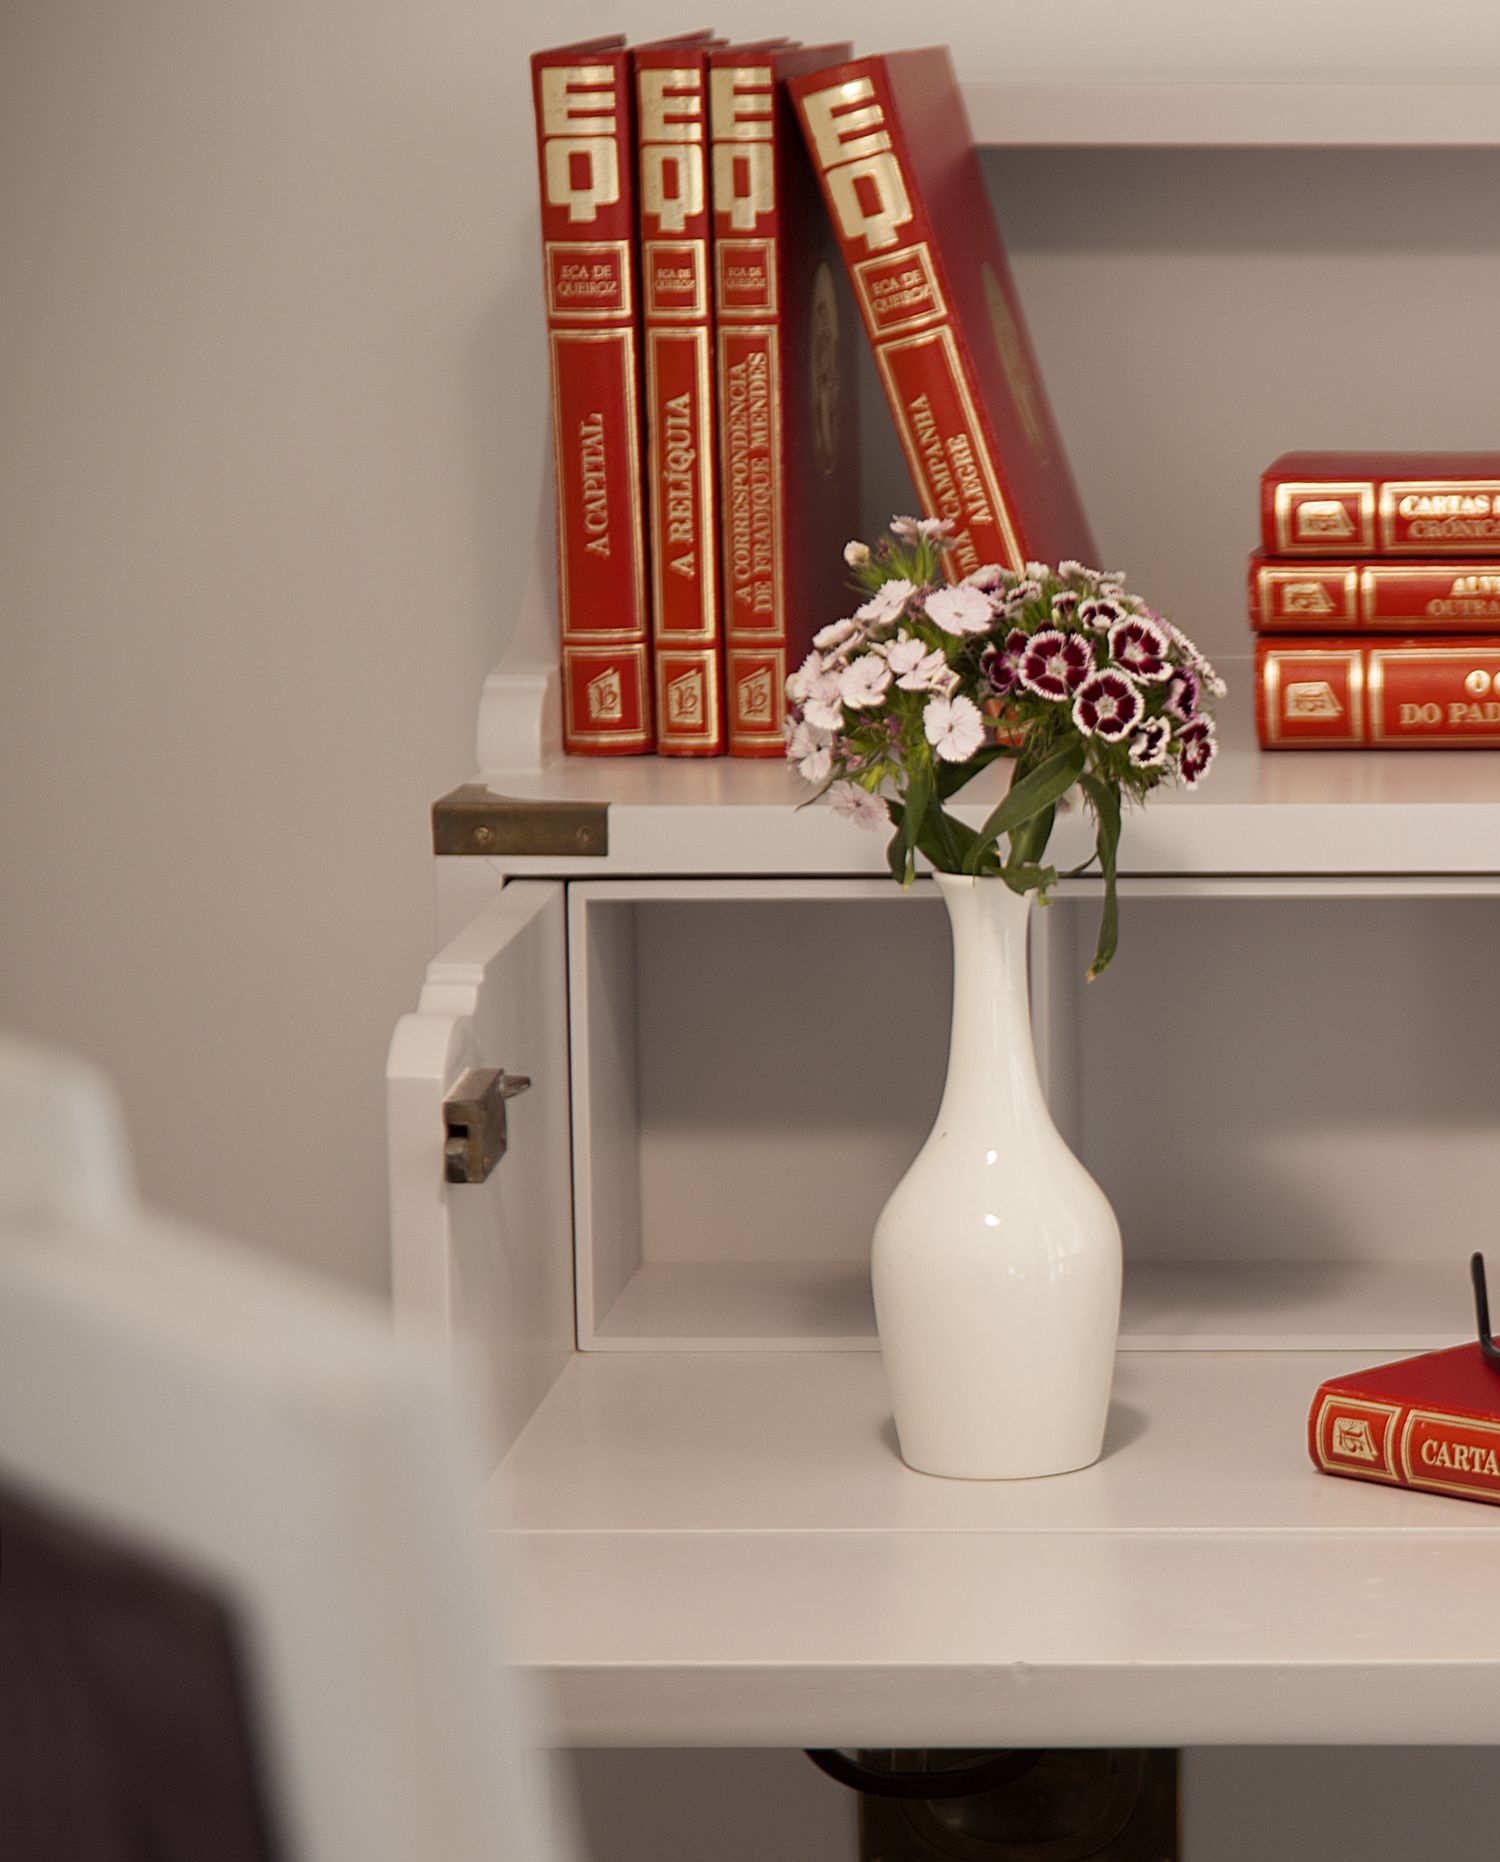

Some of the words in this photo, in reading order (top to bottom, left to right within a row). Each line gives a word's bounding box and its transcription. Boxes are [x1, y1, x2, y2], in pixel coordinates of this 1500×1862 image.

[592, 264, 612, 279] DE
[654, 279, 696, 292] QUEIROZ
[677, 267, 692, 279] DE
[557, 280, 618, 298] QUEIROZ
[748, 351, 769, 450] MENDES
[664, 392, 696, 546] RELÍQUIA
[910, 391, 962, 519] CAMPANHA
[579, 412, 609, 534] CAPITAL
[945, 433, 994, 526] ALEGRE
[750, 456, 774, 574] FRADIQUE
[1399, 493, 1490, 519] CARTAS
[584, 532, 611, 557] A
[669, 551, 696, 581] A
[735, 584, 752, 604] A
[753, 580, 773, 613] DE
[1465, 669, 1491, 697] O
[1399, 702, 1443, 726] DO
